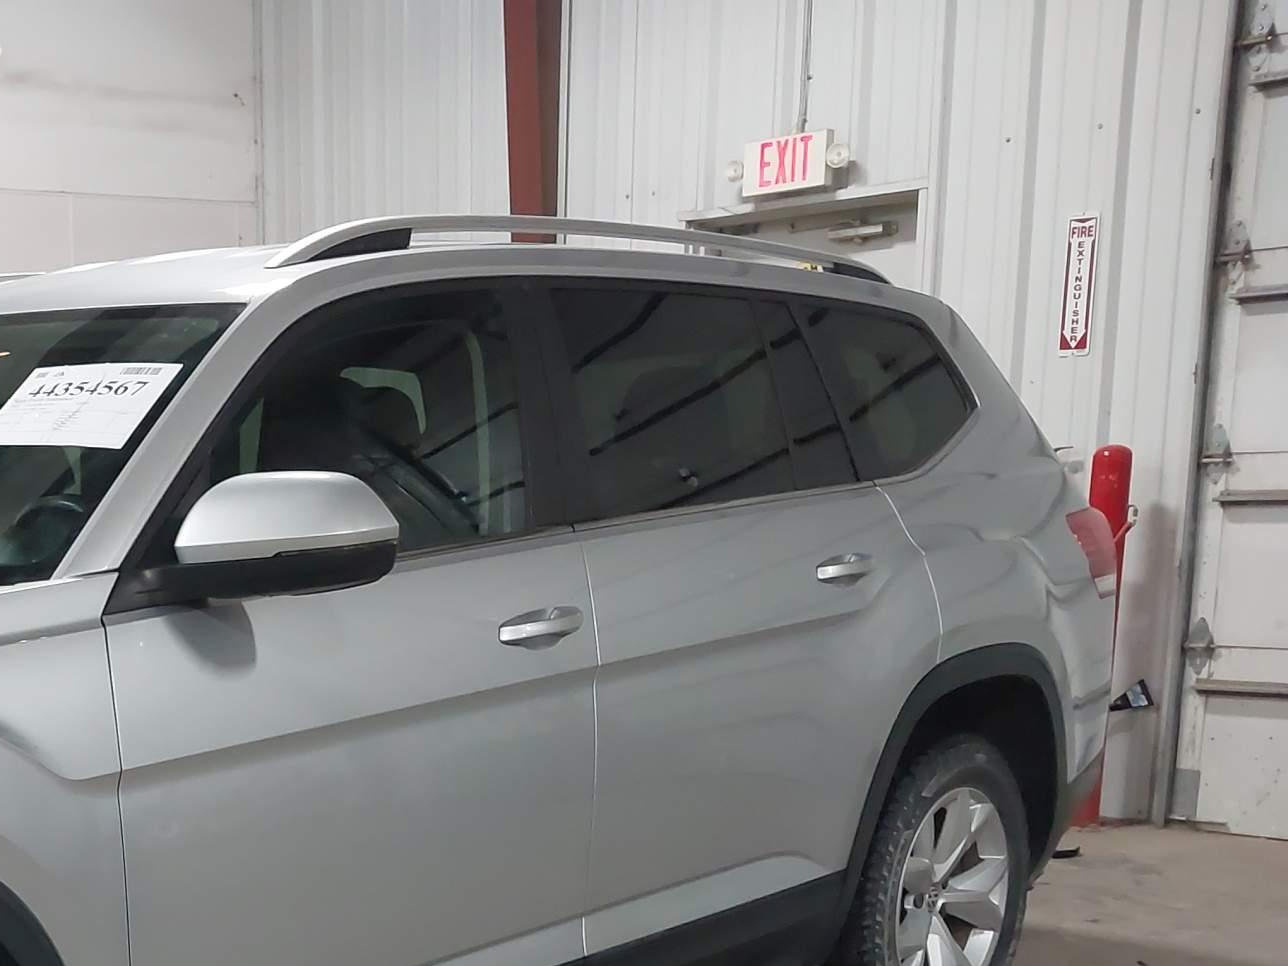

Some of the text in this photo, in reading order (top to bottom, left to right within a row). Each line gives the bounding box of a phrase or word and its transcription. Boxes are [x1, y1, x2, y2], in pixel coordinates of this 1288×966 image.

[758, 134, 814, 188] EXIT
[1071, 225, 1095, 239] FIRE
[1069, 240, 1086, 343] EXTINGUISHER
[28, 379, 150, 398] 44354567
